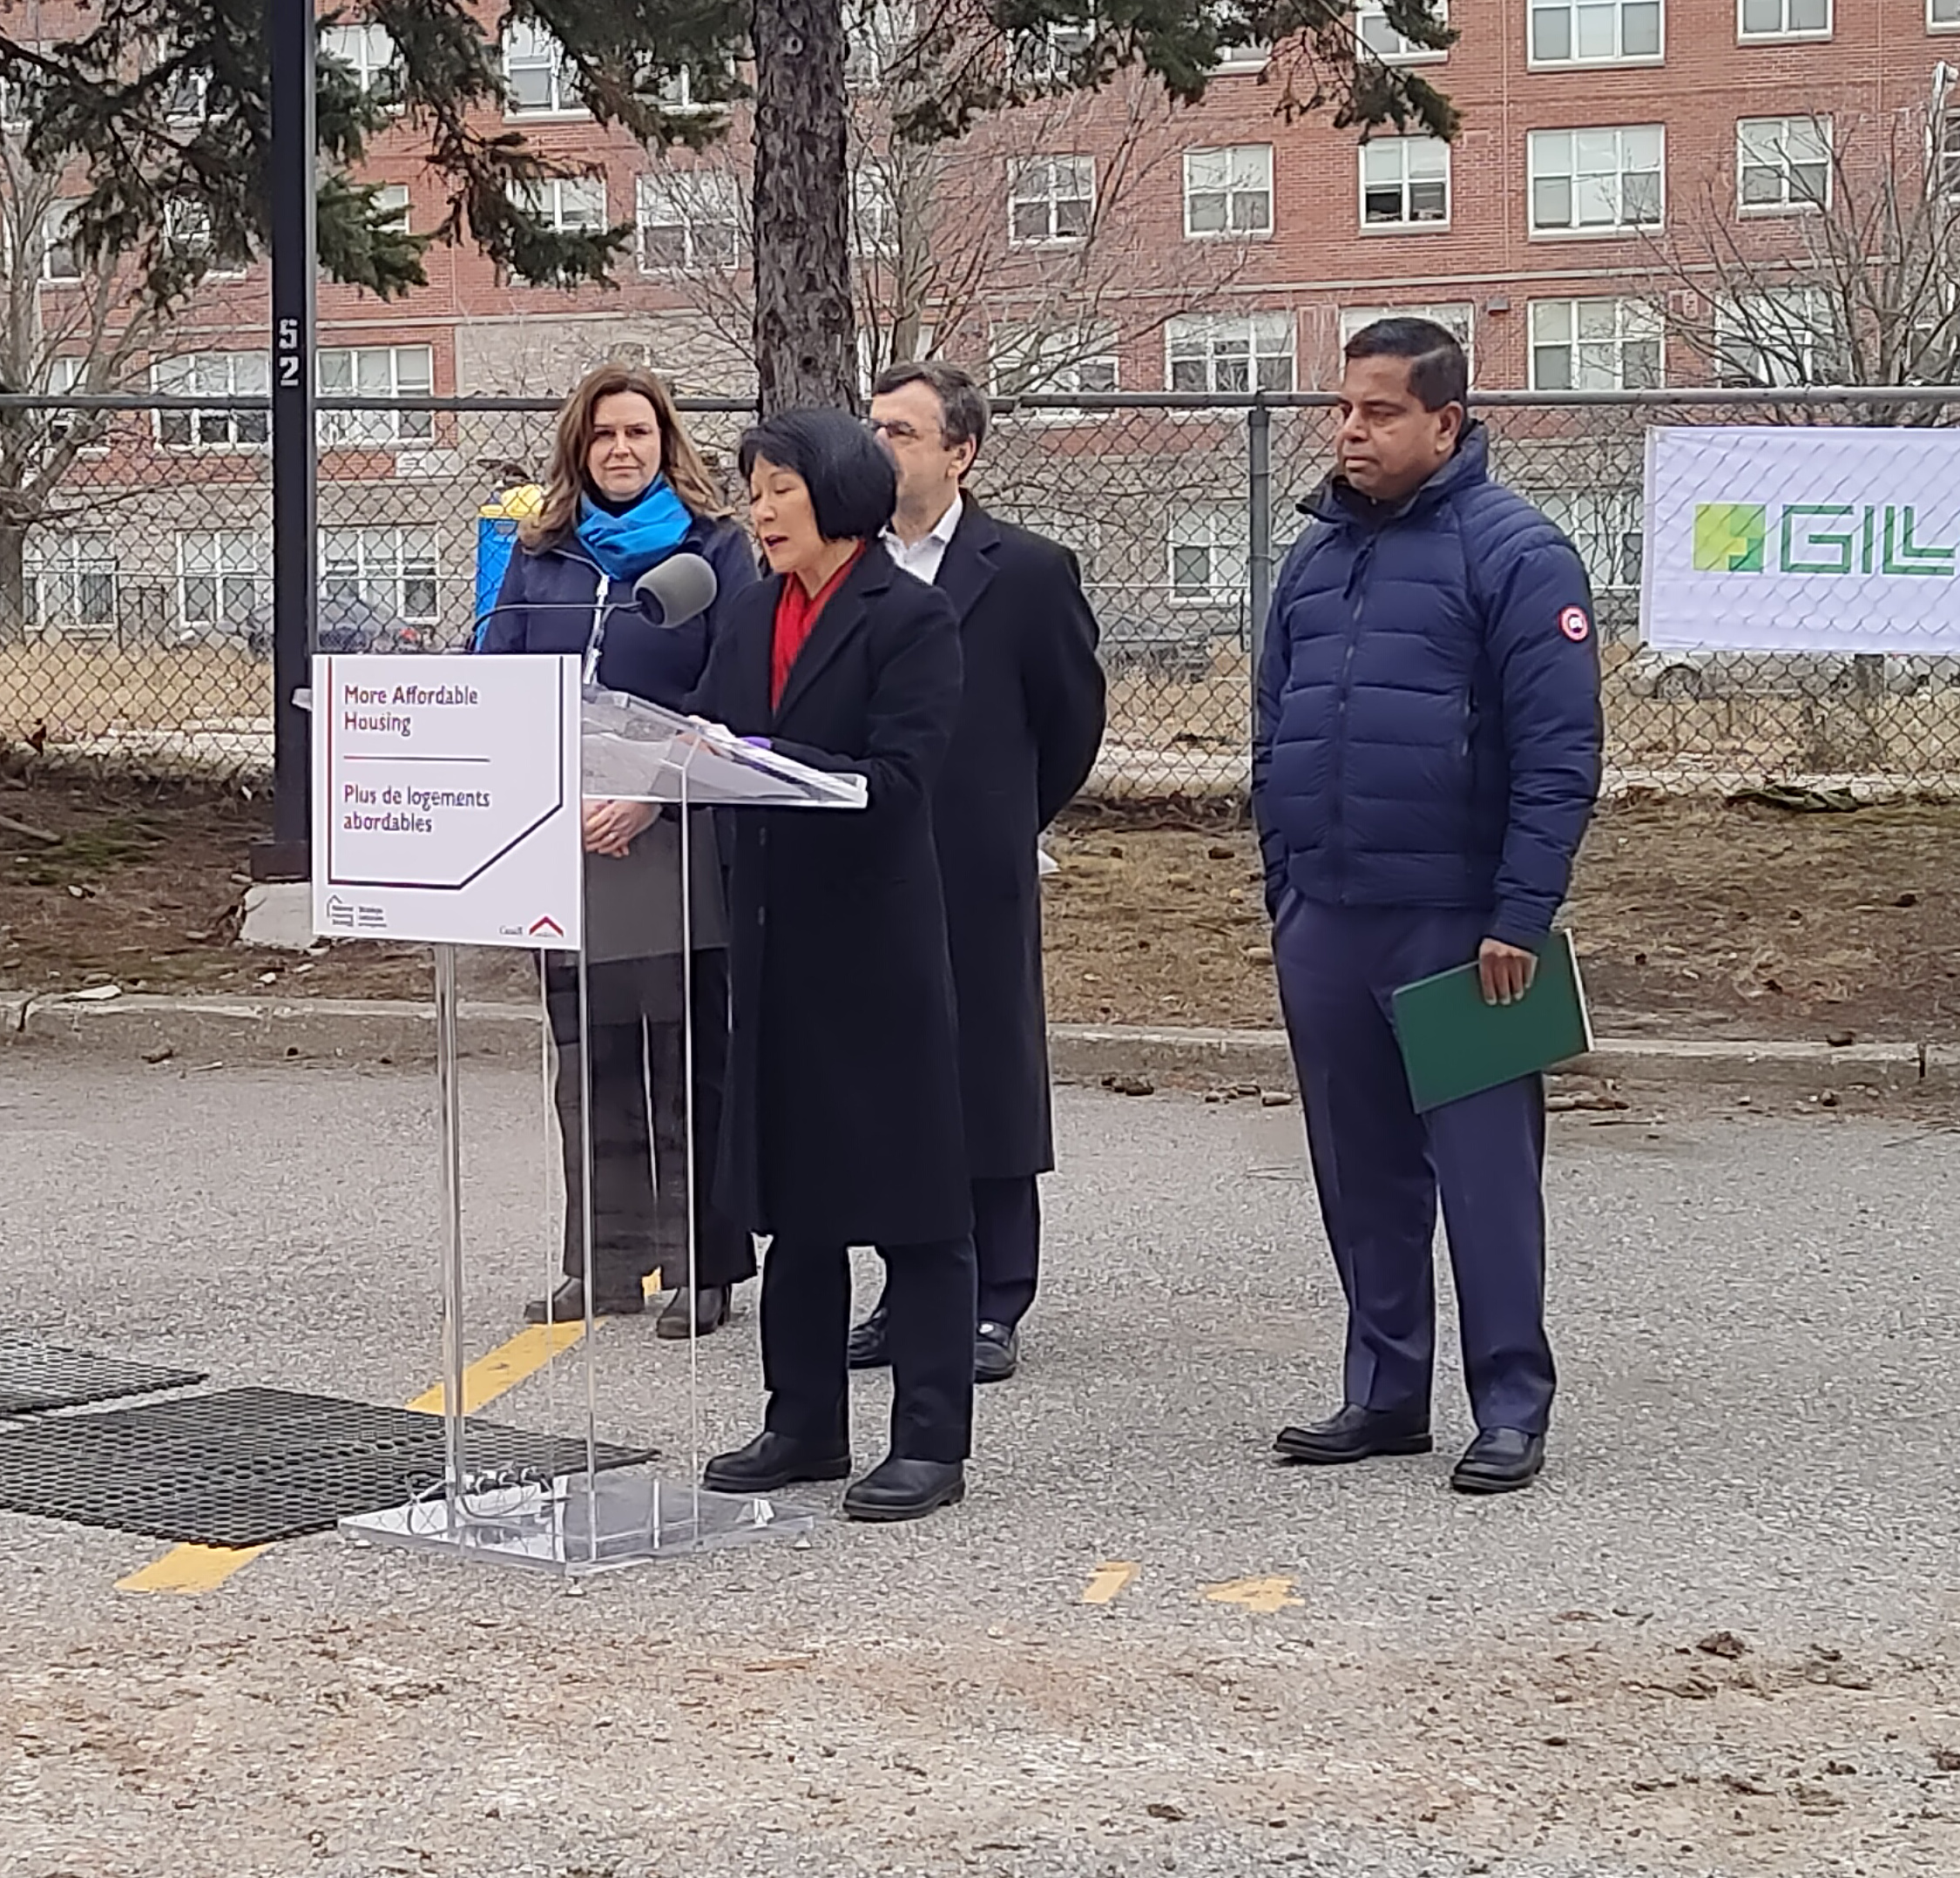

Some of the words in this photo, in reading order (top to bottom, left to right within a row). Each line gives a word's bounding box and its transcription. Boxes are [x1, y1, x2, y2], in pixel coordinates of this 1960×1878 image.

[344, 685, 387, 706] More
[392, 685, 478, 706] Affordable
[344, 711, 411, 737] Housing
[343, 784, 376, 805] Plus
[382, 786, 402, 805] de
[407, 786, 490, 812] logements
[343, 811, 432, 833] abordables
